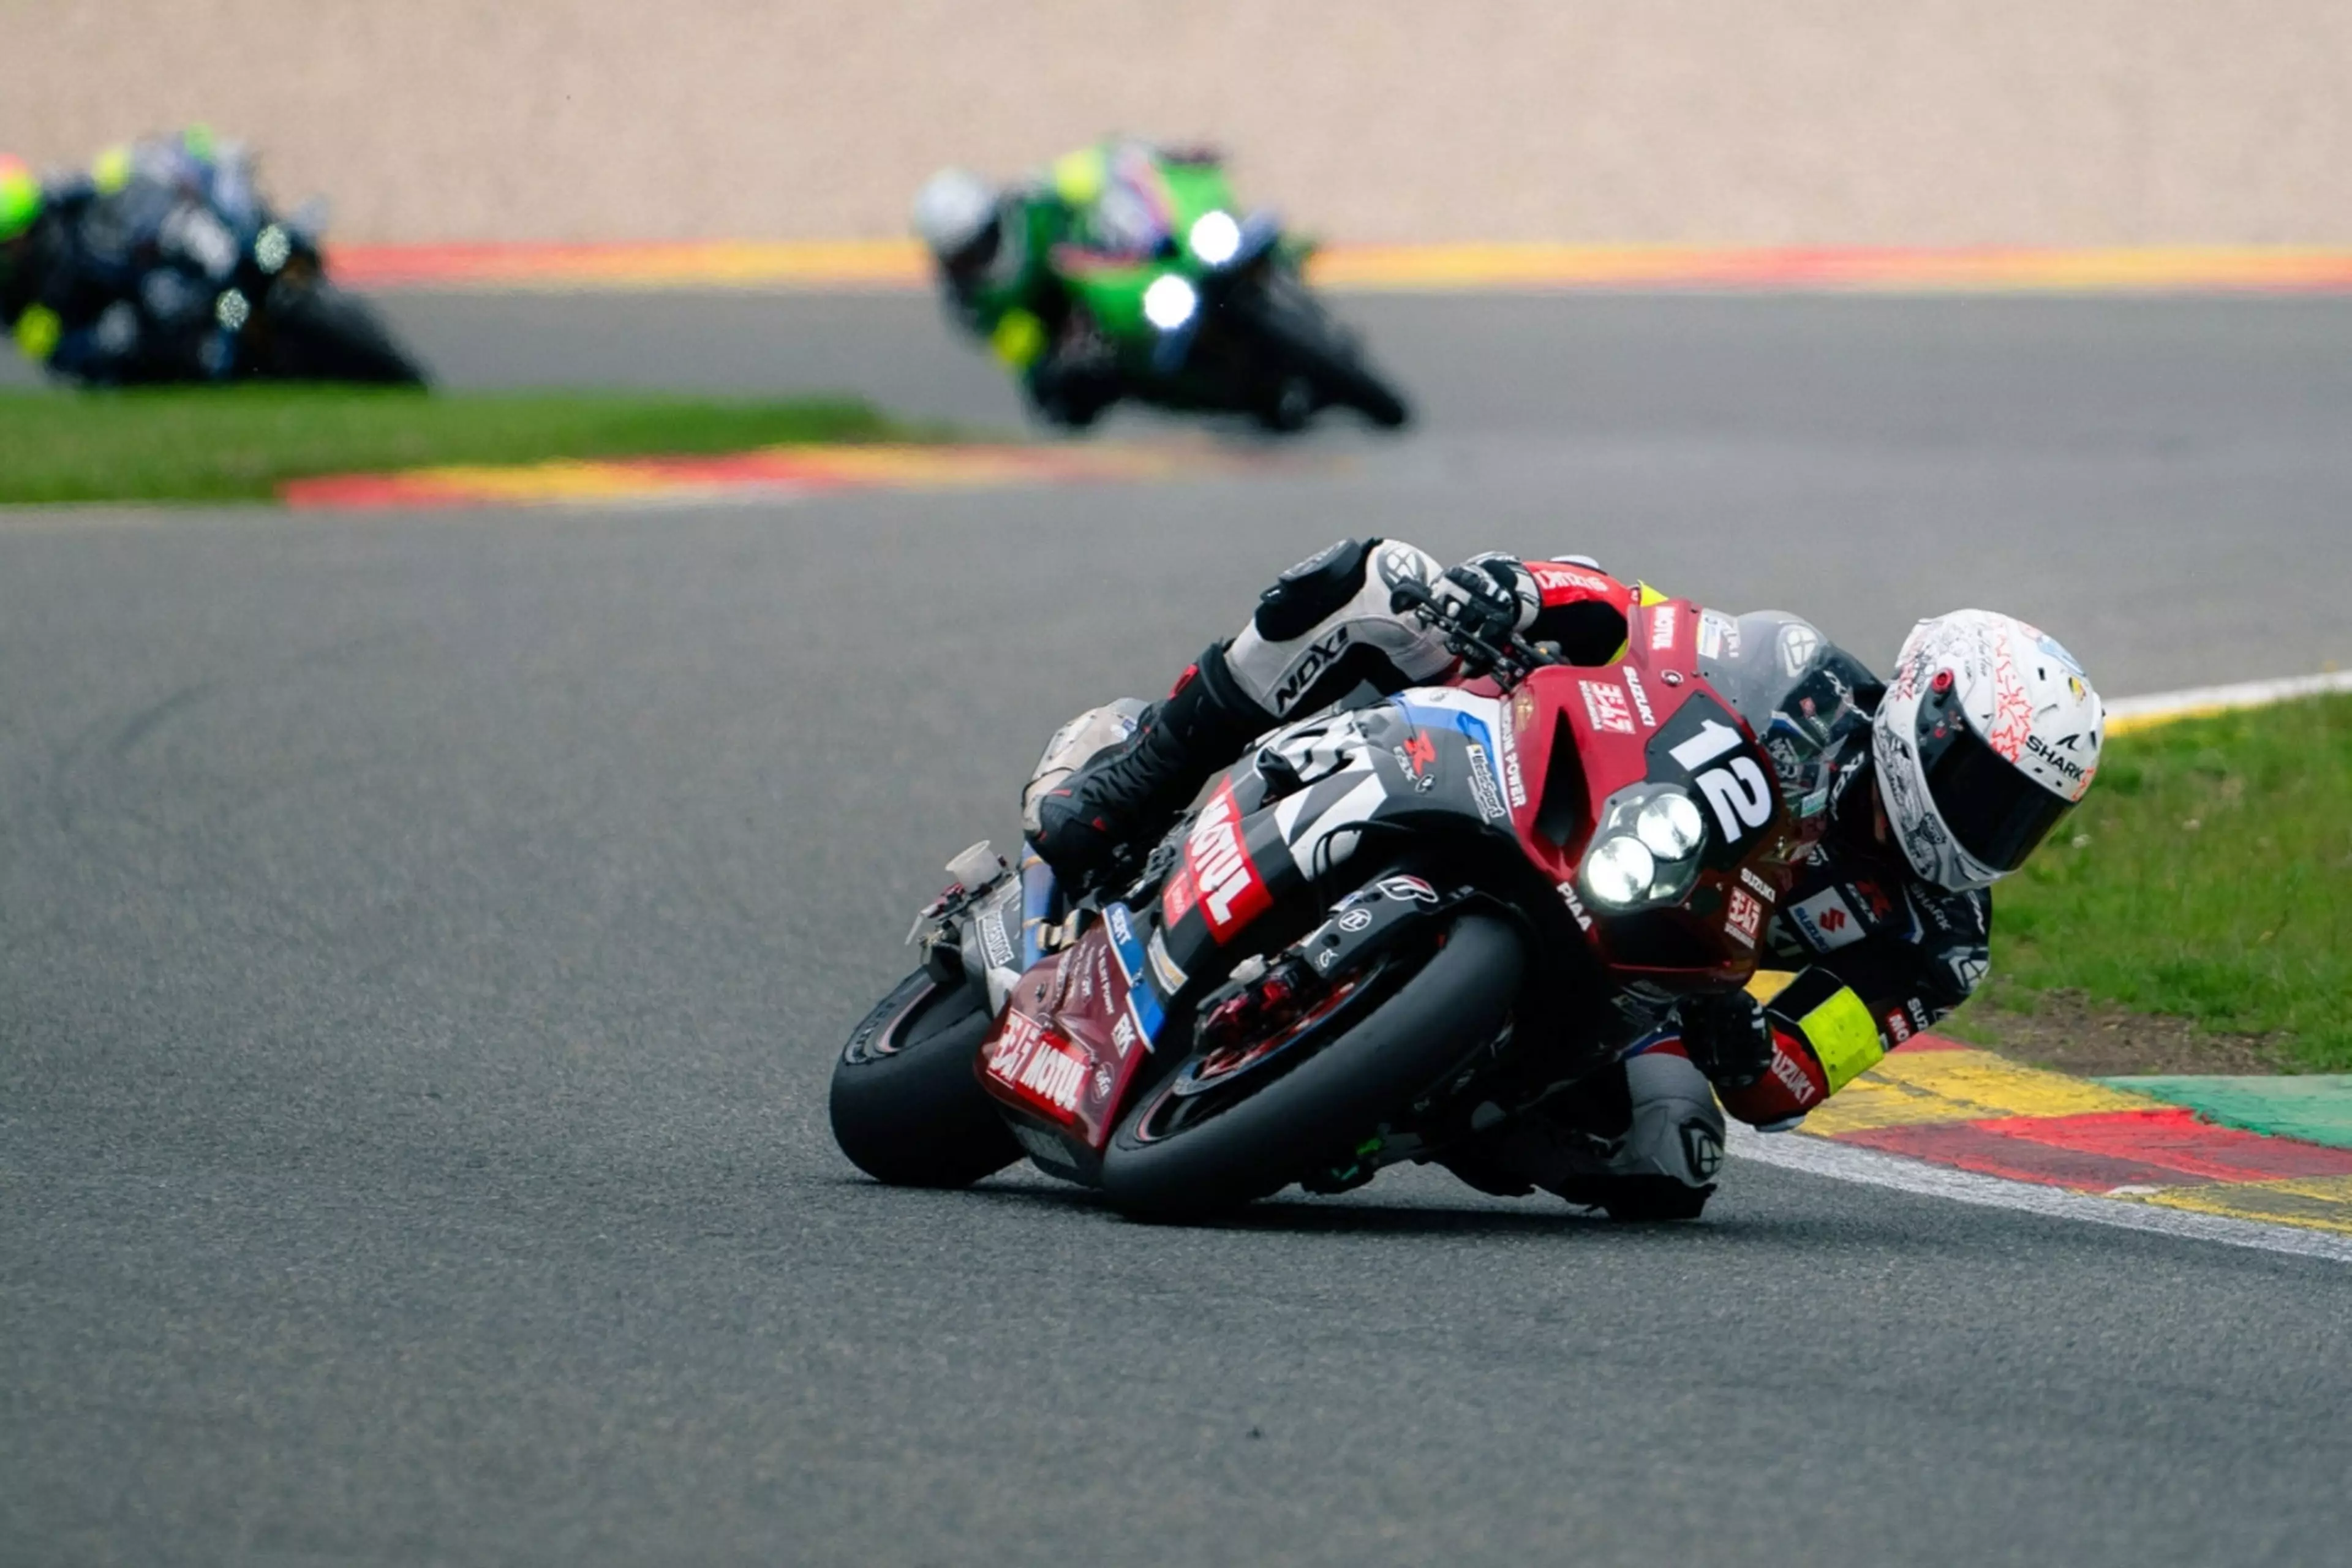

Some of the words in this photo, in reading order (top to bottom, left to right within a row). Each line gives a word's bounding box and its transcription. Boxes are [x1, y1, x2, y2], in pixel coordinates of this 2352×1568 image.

[1653, 605, 1676, 650] MOTUL
[1623, 665, 1656, 727] SUZUKI
[1505, 752, 1527, 808] POWER
[1668, 718, 1773, 844] 12
[2025, 734, 2086, 783] SHARK
[1189, 792, 1253, 926] MOTUL
[1556, 881, 1593, 932] PIAA
[1740, 867, 1776, 903] SUZUKI
[1910, 883, 1952, 931] SHARK
[1112, 908, 1131, 945] SERT
[1112, 1012, 1136, 1058] RK
[1907, 997, 1931, 1031] SUZ
[1018, 1040, 1085, 1111] MOTUL
